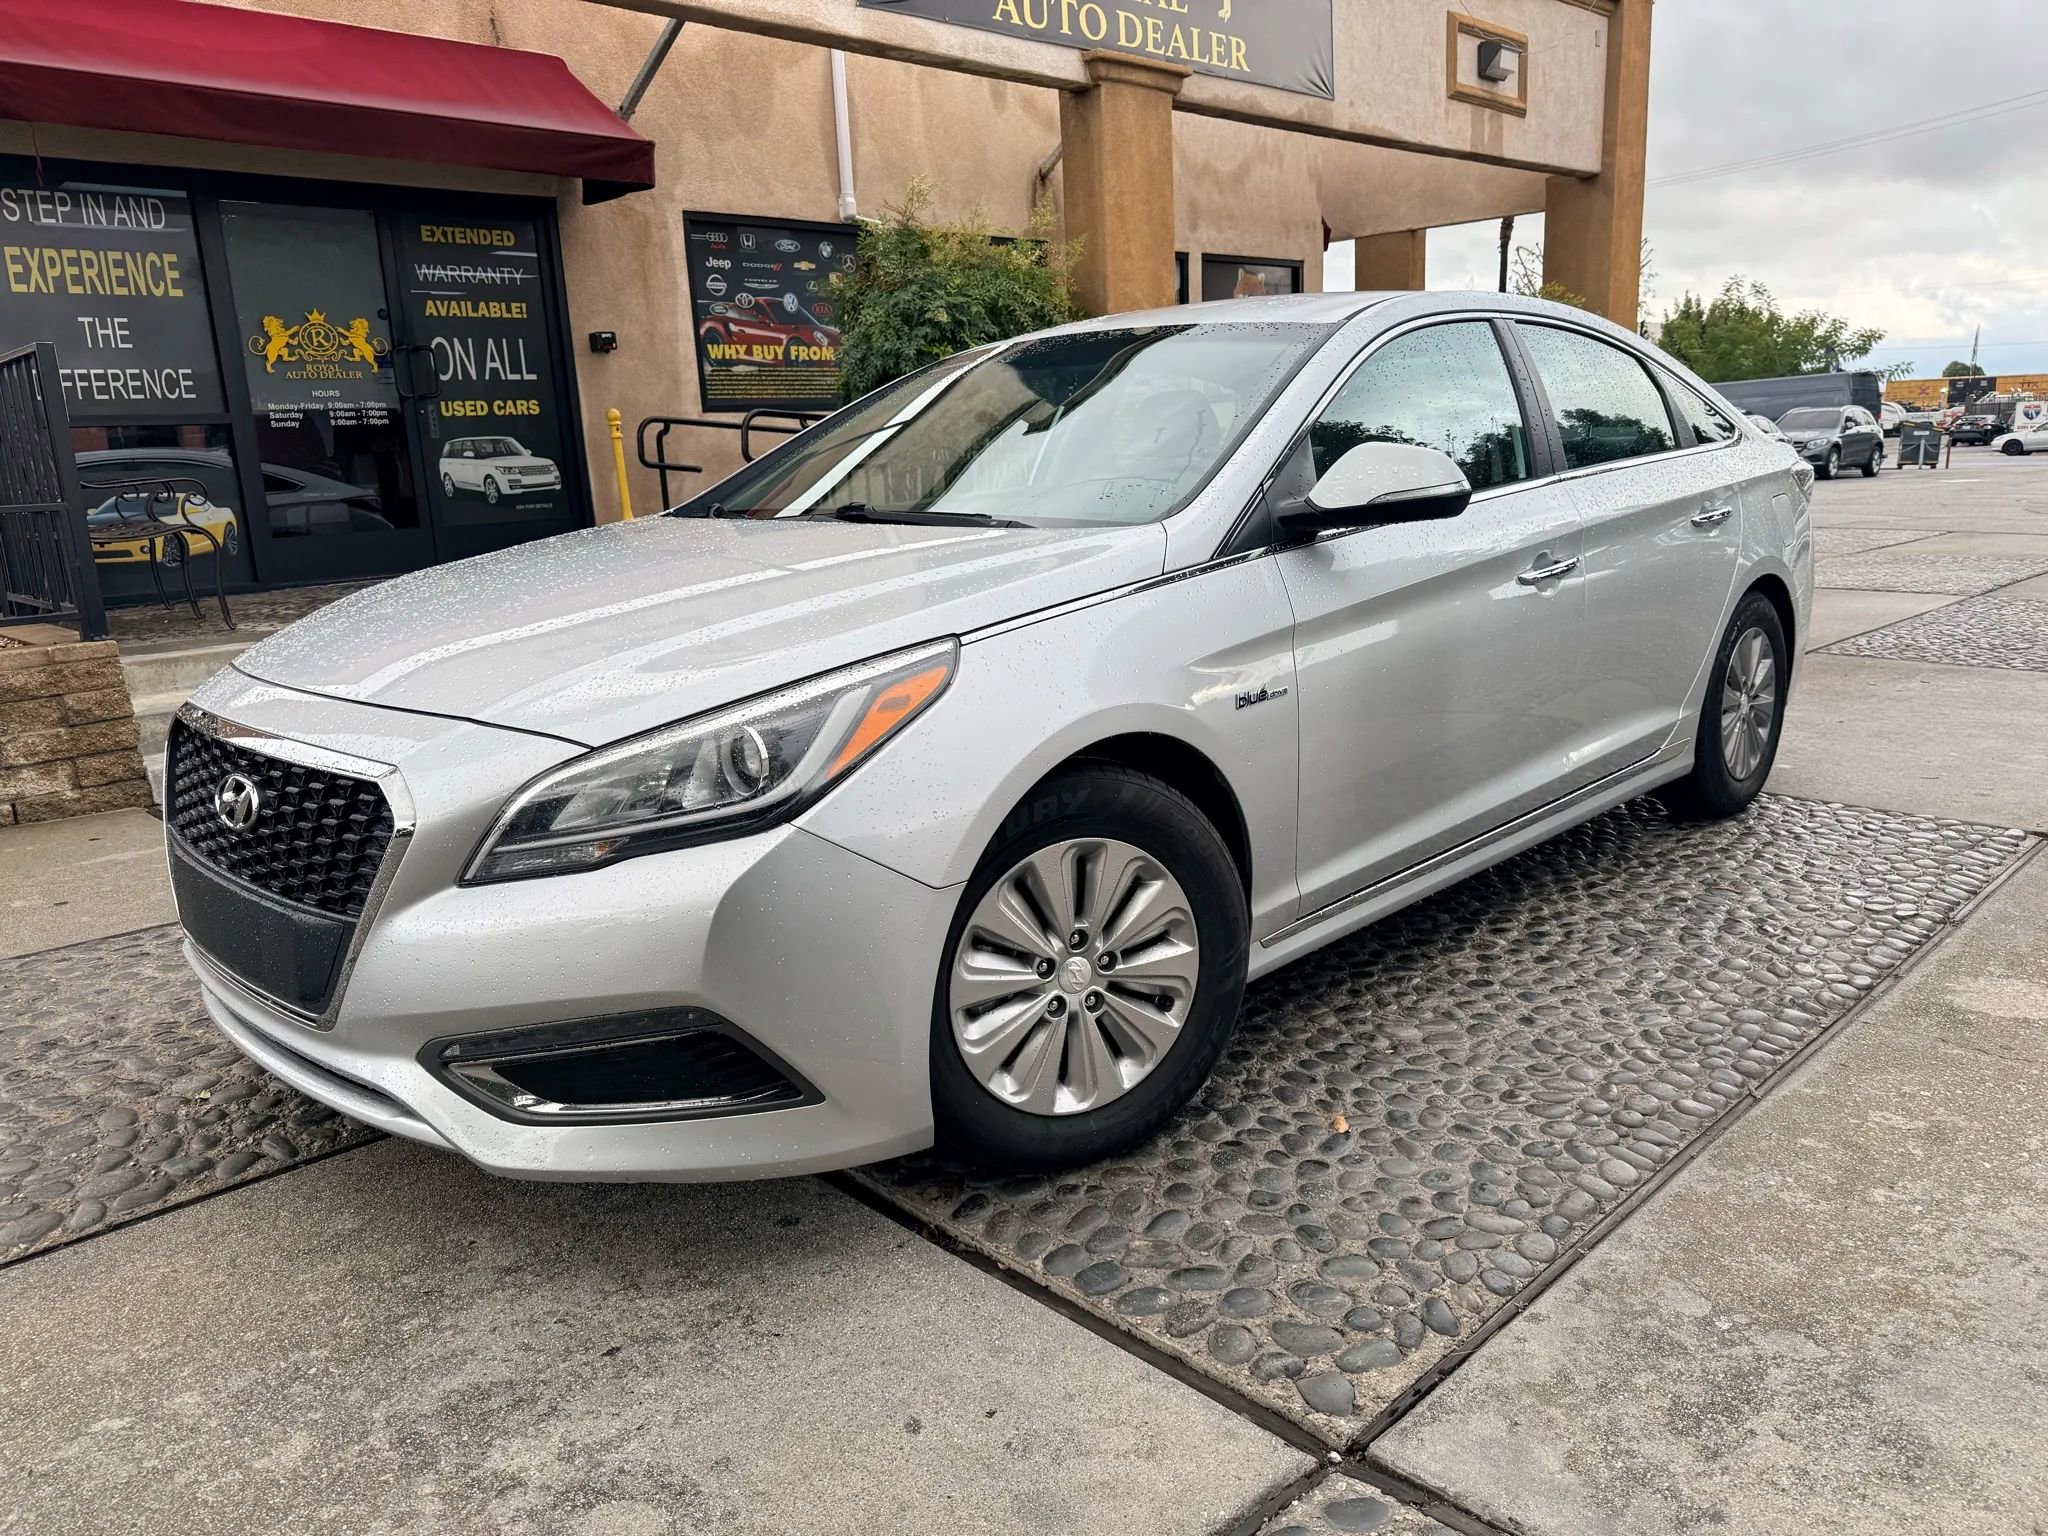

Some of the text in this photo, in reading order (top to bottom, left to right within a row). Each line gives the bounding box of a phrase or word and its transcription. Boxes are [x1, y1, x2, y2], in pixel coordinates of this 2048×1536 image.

[992, 0, 1251, 73] AUTO DEALER
[0, 187, 166, 229] STEP IN AND
[420, 224, 515, 246] EXTENDED
[3, 246, 184, 297] EXPERIENCE
[705, 256, 731, 270] Jeep
[414, 263, 524, 285] WARRANTY
[425, 300, 528, 319] AVAILABLE!
[814, 305, 829, 314] KIA
[77, 317, 133, 348] THE
[311, 327, 329, 347] R
[430, 336, 538, 381] ON ALL
[707, 344, 836, 361] WHY BUY FROM
[285, 371, 364, 379] AUTO DEALER
[305, 363, 343, 372] ROYAL
[32, 369, 197, 400] FFERENCE
[267, 403, 324, 411] Monday-Friday
[360, 401, 387, 410] 7:00pm
[269, 411, 303, 419] Saturday
[361, 410, 388, 418] 7:00pm
[440, 400, 540, 417] USED CARS
[270, 420, 300, 429] Sunday
[363, 418, 390, 426] 7:00pm
[1235, 684, 1268, 710] blue
